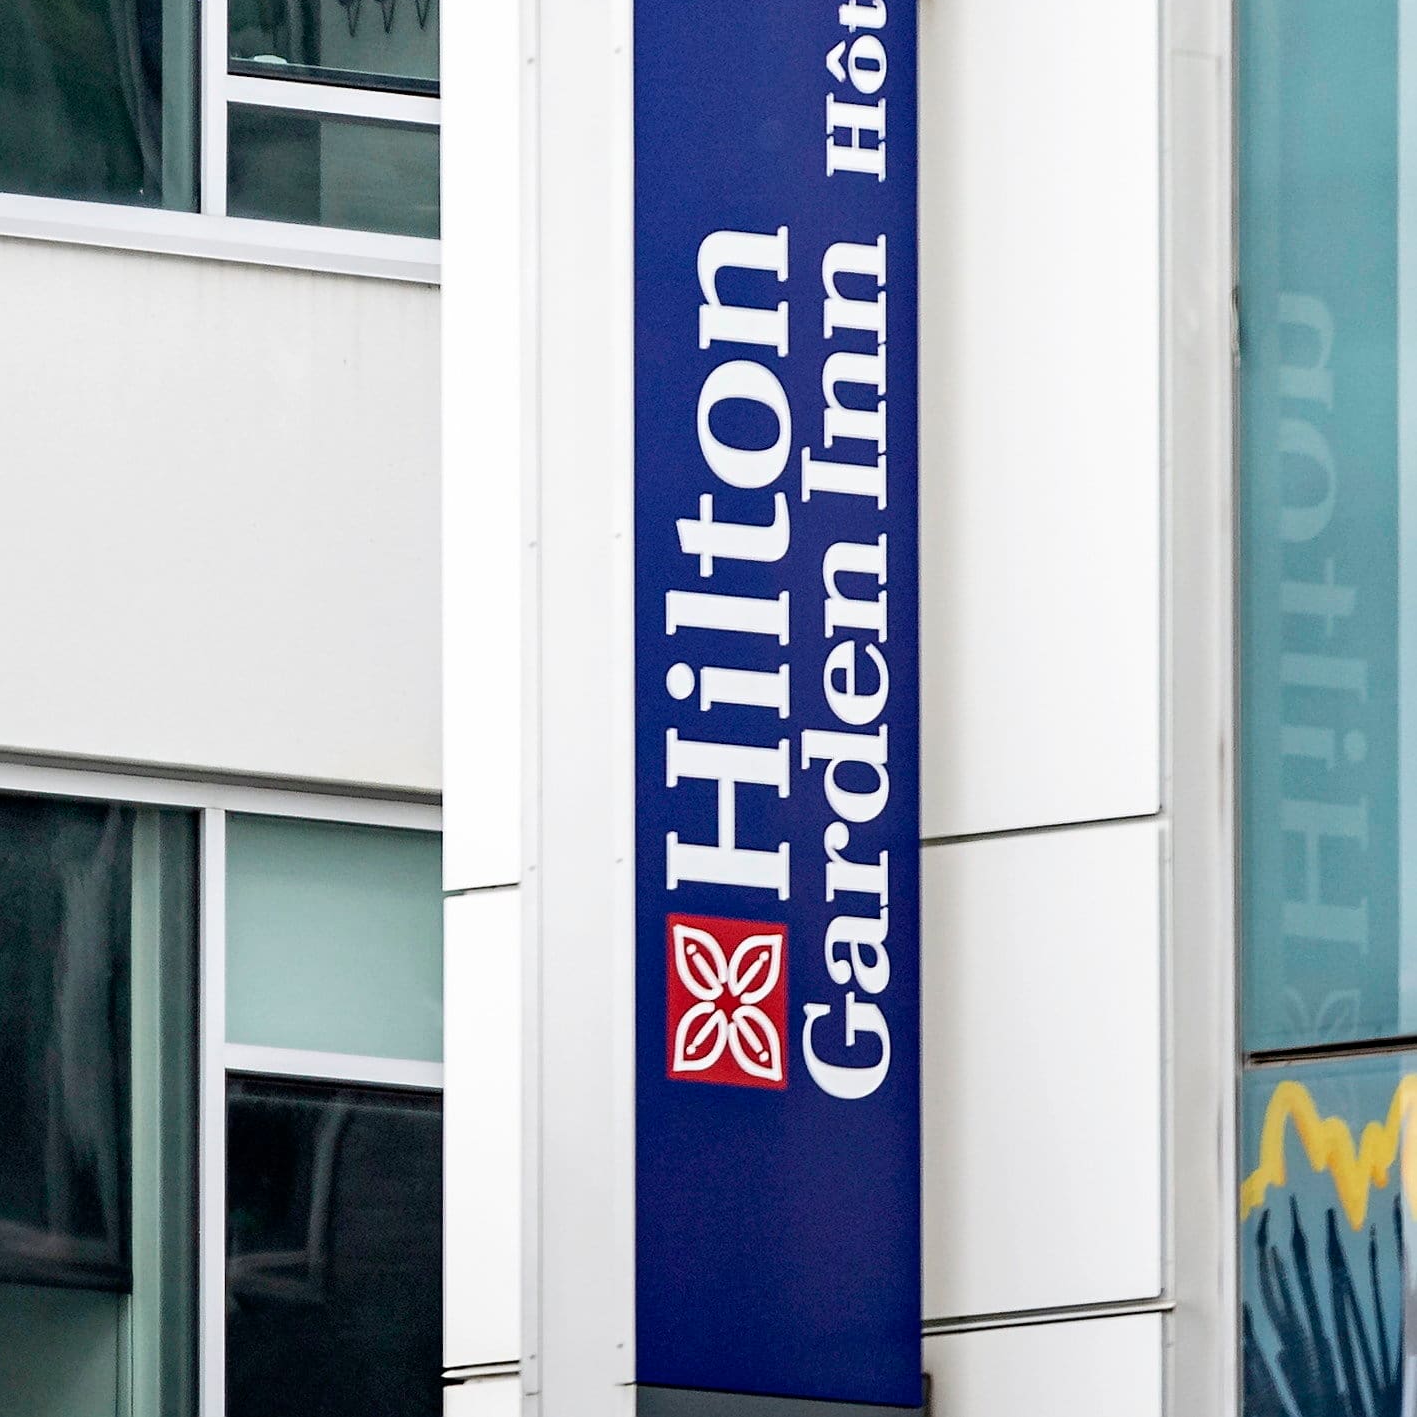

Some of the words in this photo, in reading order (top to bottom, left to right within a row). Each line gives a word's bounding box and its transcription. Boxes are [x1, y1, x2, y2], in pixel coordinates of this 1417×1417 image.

[665, 224, 792, 901] Hilton
[801, 234, 888, 511] Inn
[801, 533, 891, 1099] Garden
